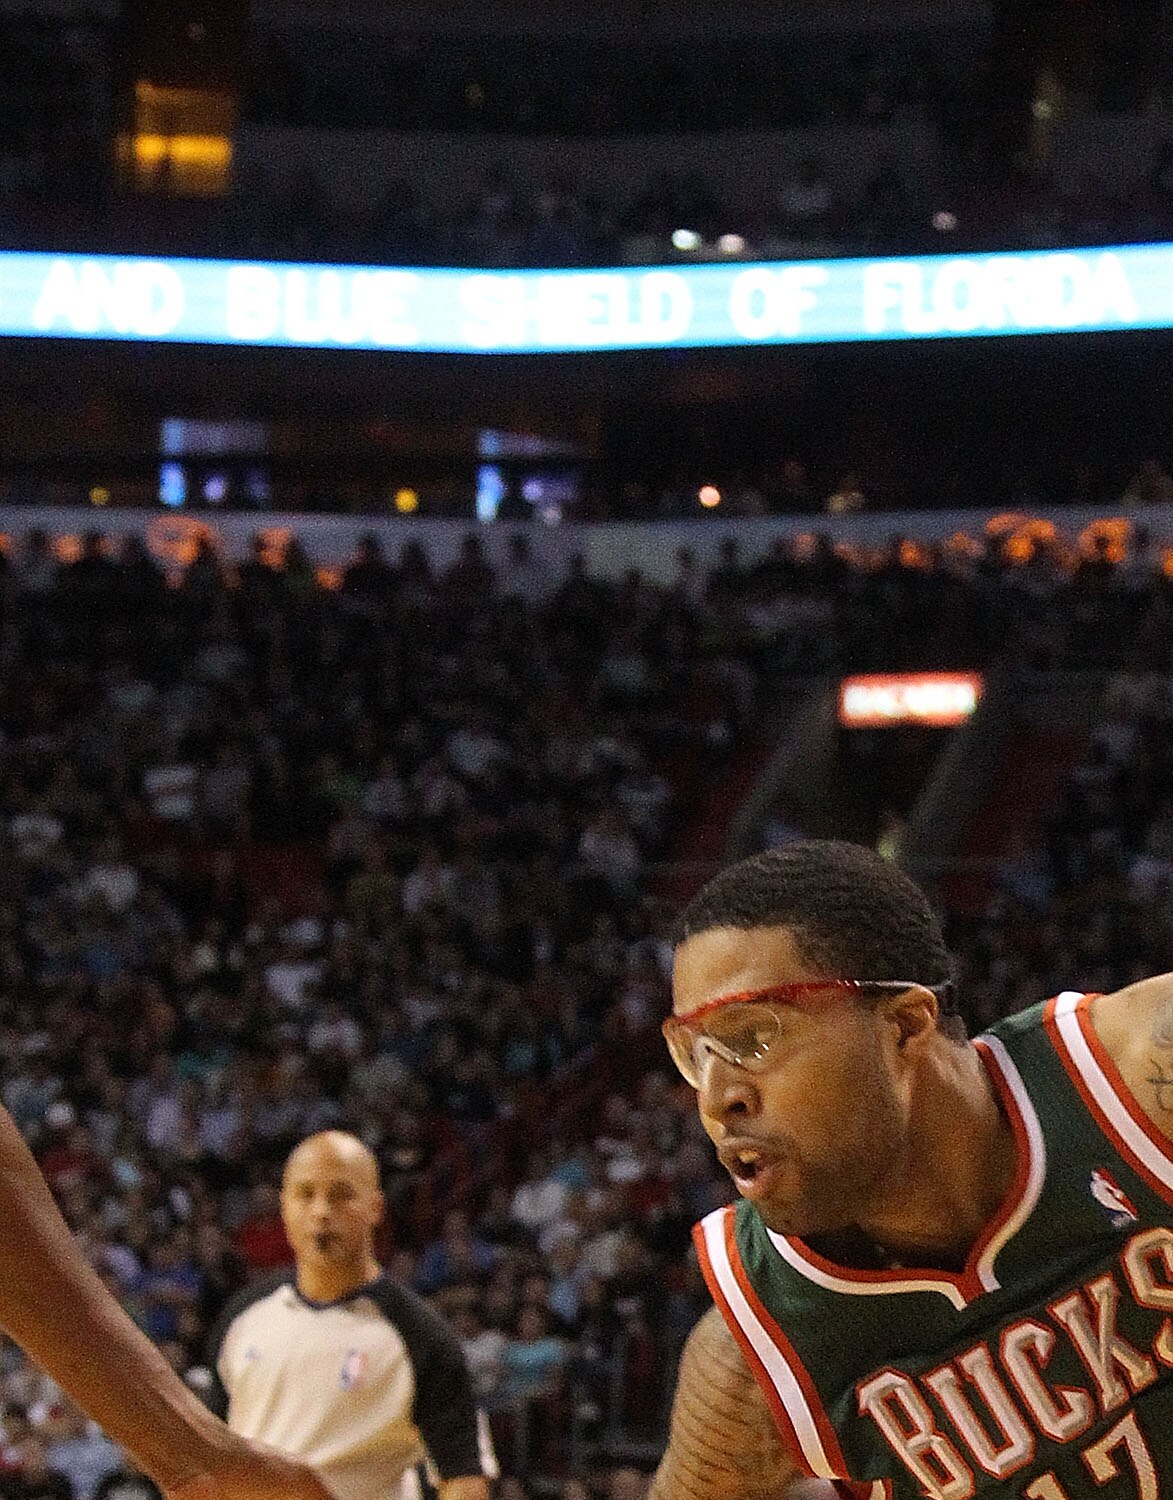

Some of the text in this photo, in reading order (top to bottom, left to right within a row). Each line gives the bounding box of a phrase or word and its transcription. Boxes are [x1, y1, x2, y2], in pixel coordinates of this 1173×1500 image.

[32, 252, 1139, 348] AND BLUE SHIELD OF FLORIDA
